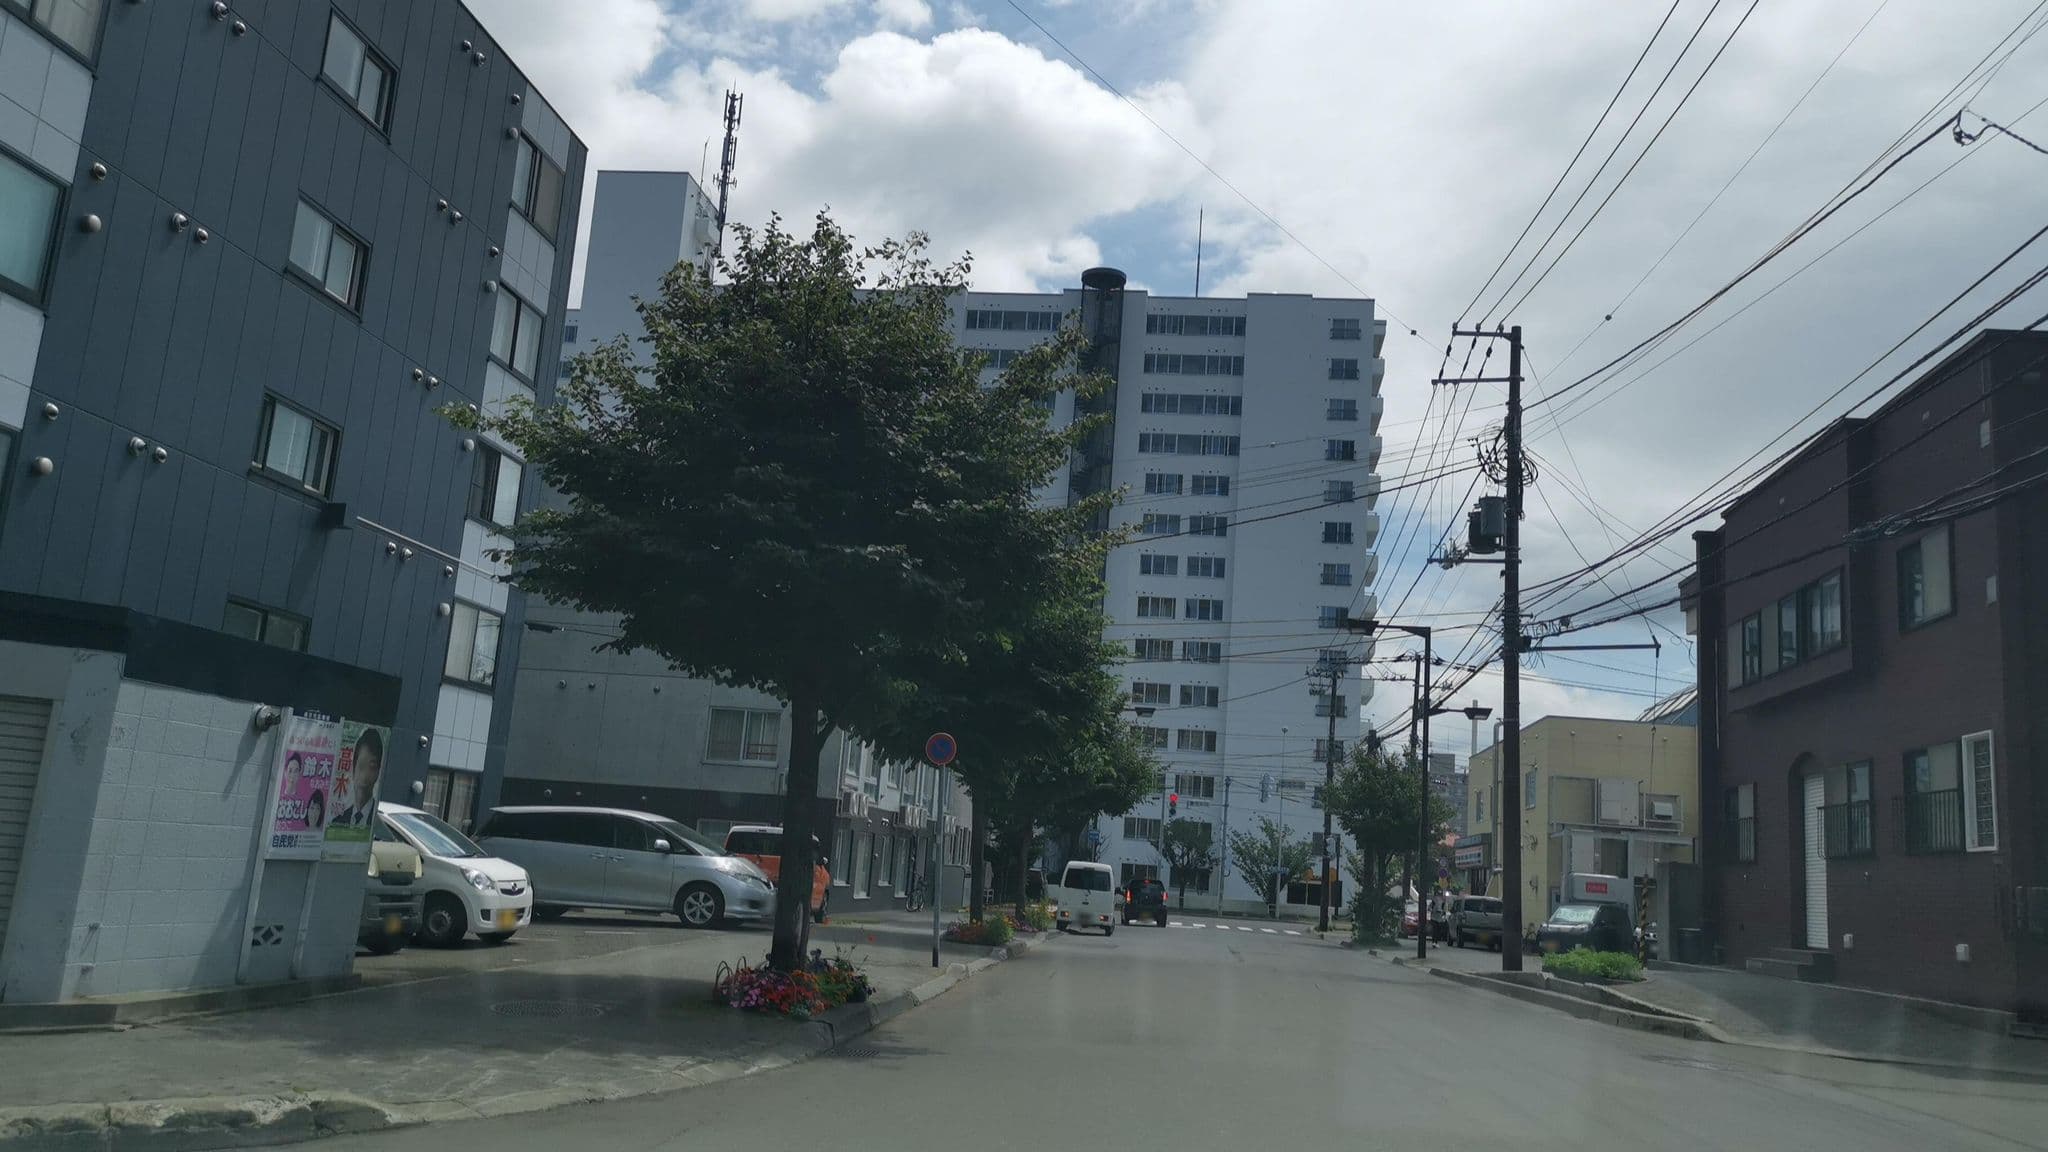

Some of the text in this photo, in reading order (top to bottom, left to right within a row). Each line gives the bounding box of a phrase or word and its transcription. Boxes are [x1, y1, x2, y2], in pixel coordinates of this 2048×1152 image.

[303, 756, 332, 778] 鈴木
[333, 747, 353, 799] 高木
[277, 799, 308, 819] おおこし
[272, 834, 295, 848] 自民党
